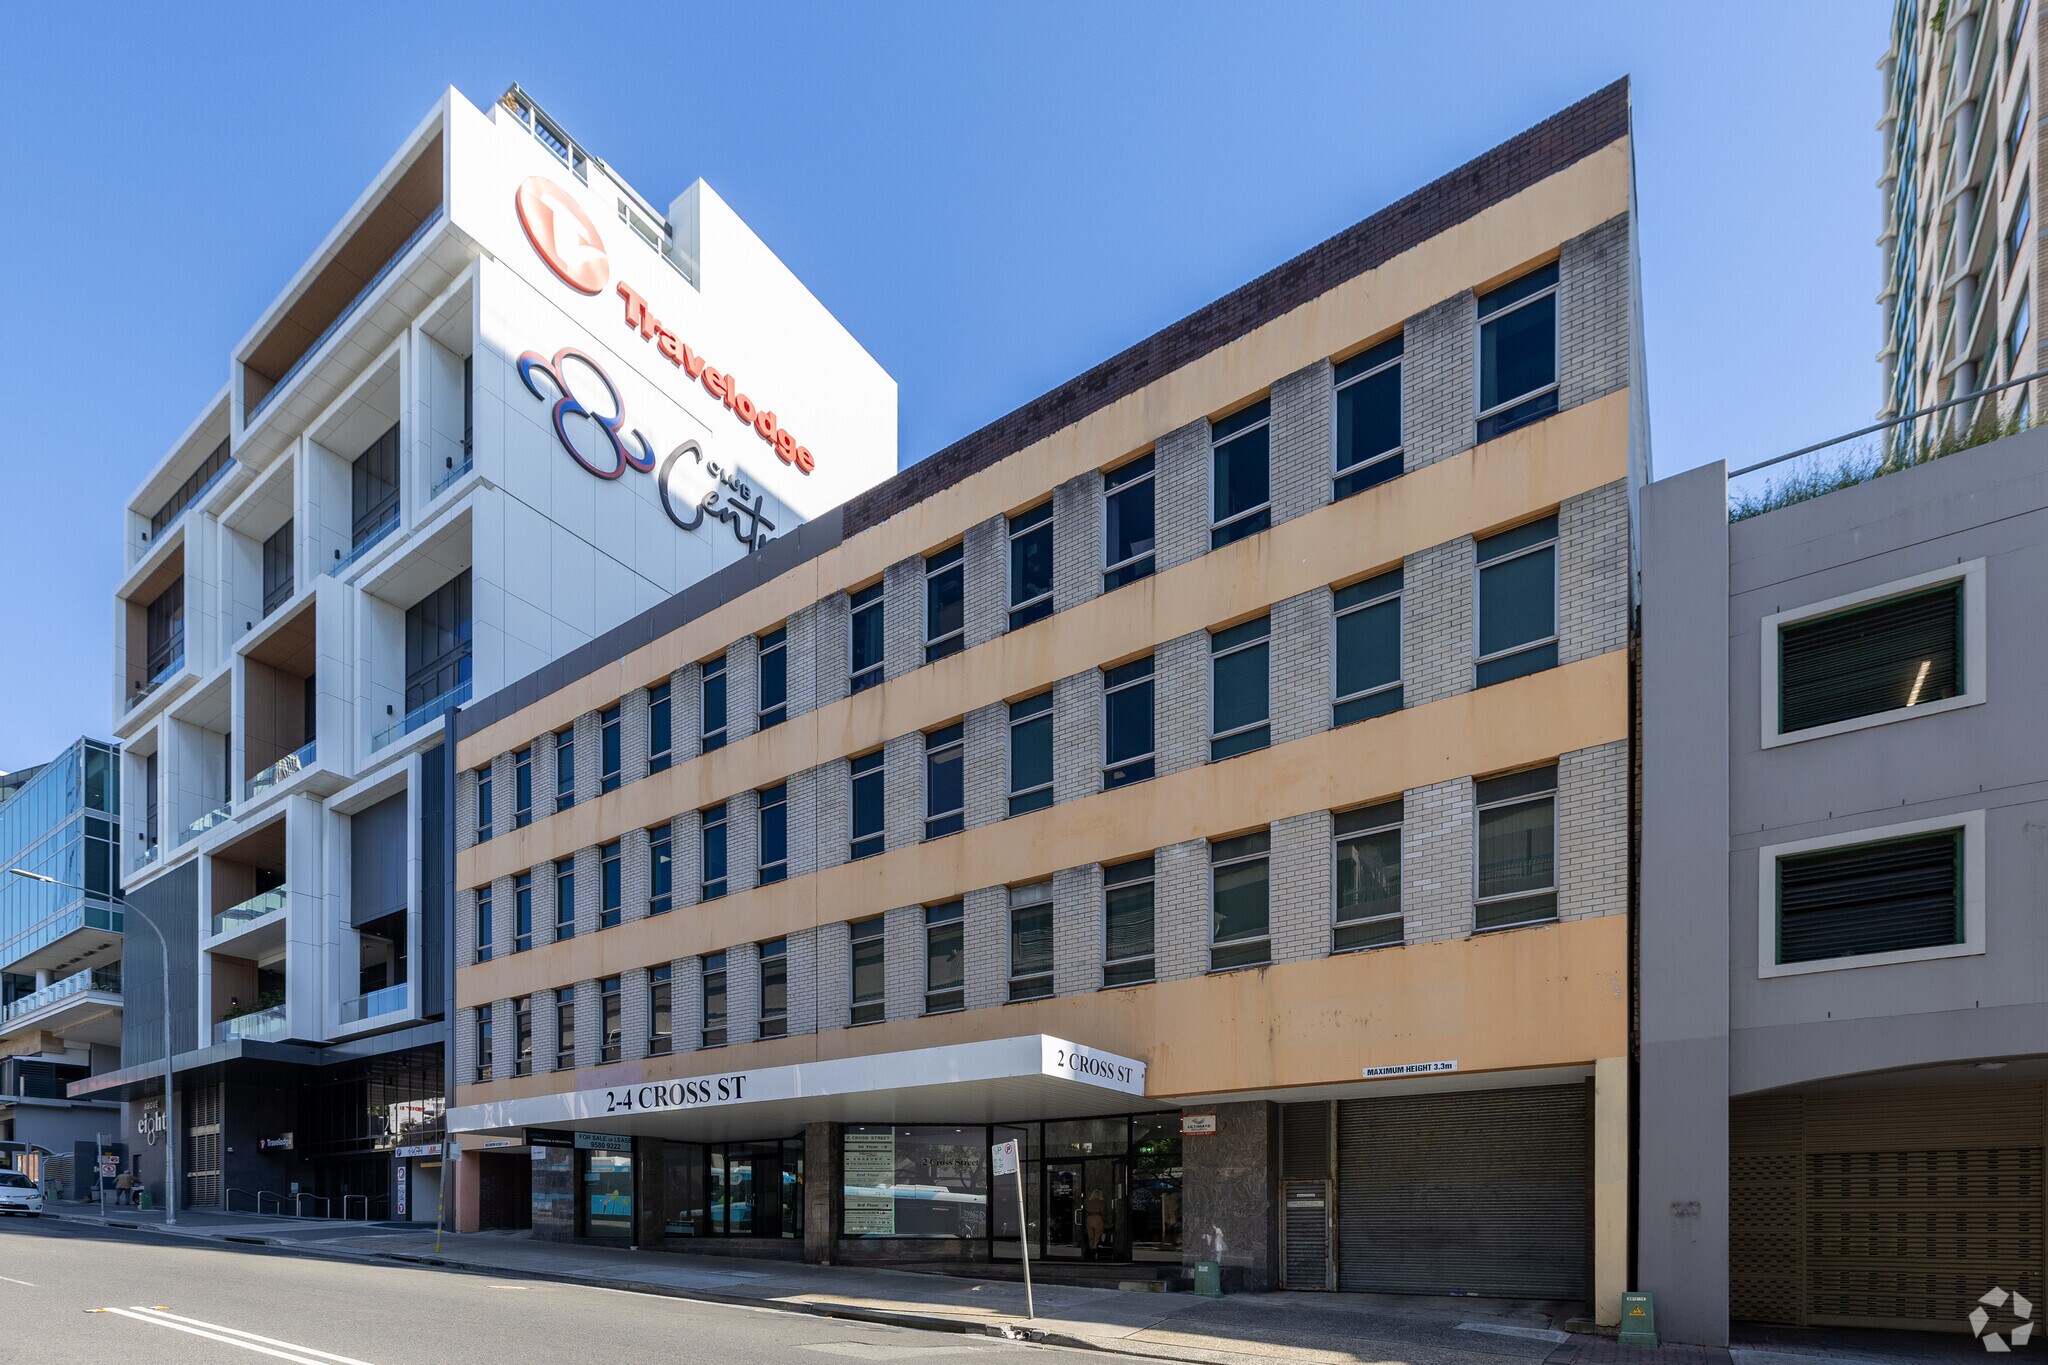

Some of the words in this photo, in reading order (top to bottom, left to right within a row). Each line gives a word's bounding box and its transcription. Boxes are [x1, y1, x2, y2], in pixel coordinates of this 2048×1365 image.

[616, 280, 815, 476] Travelodge
[706, 460, 752, 501] CLUB
[1057, 1049, 1065, 1067] 2
[1068, 1053, 1114, 1080] CROSS
[1117, 1065, 1133, 1083] ST
[1367, 1066, 1404, 1076] MAXIMUM
[1405, 1063, 1432, 1073] HEIGHT
[1433, 1062, 1453, 1071] 3.3m
[144, 1100, 159, 1110] ABOVE
[606, 1088, 633, 1112] 2-4
[638, 1079, 711, 1109] CROSS
[717, 1075, 747, 1101] ST
[138, 1111, 168, 1146] eight
[266, 1138, 292, 1147] Travelodge
[922, 1158, 928, 1166] 2
[929, 1158, 953, 1166] Cross
[954, 1158, 979, 1166] Street
